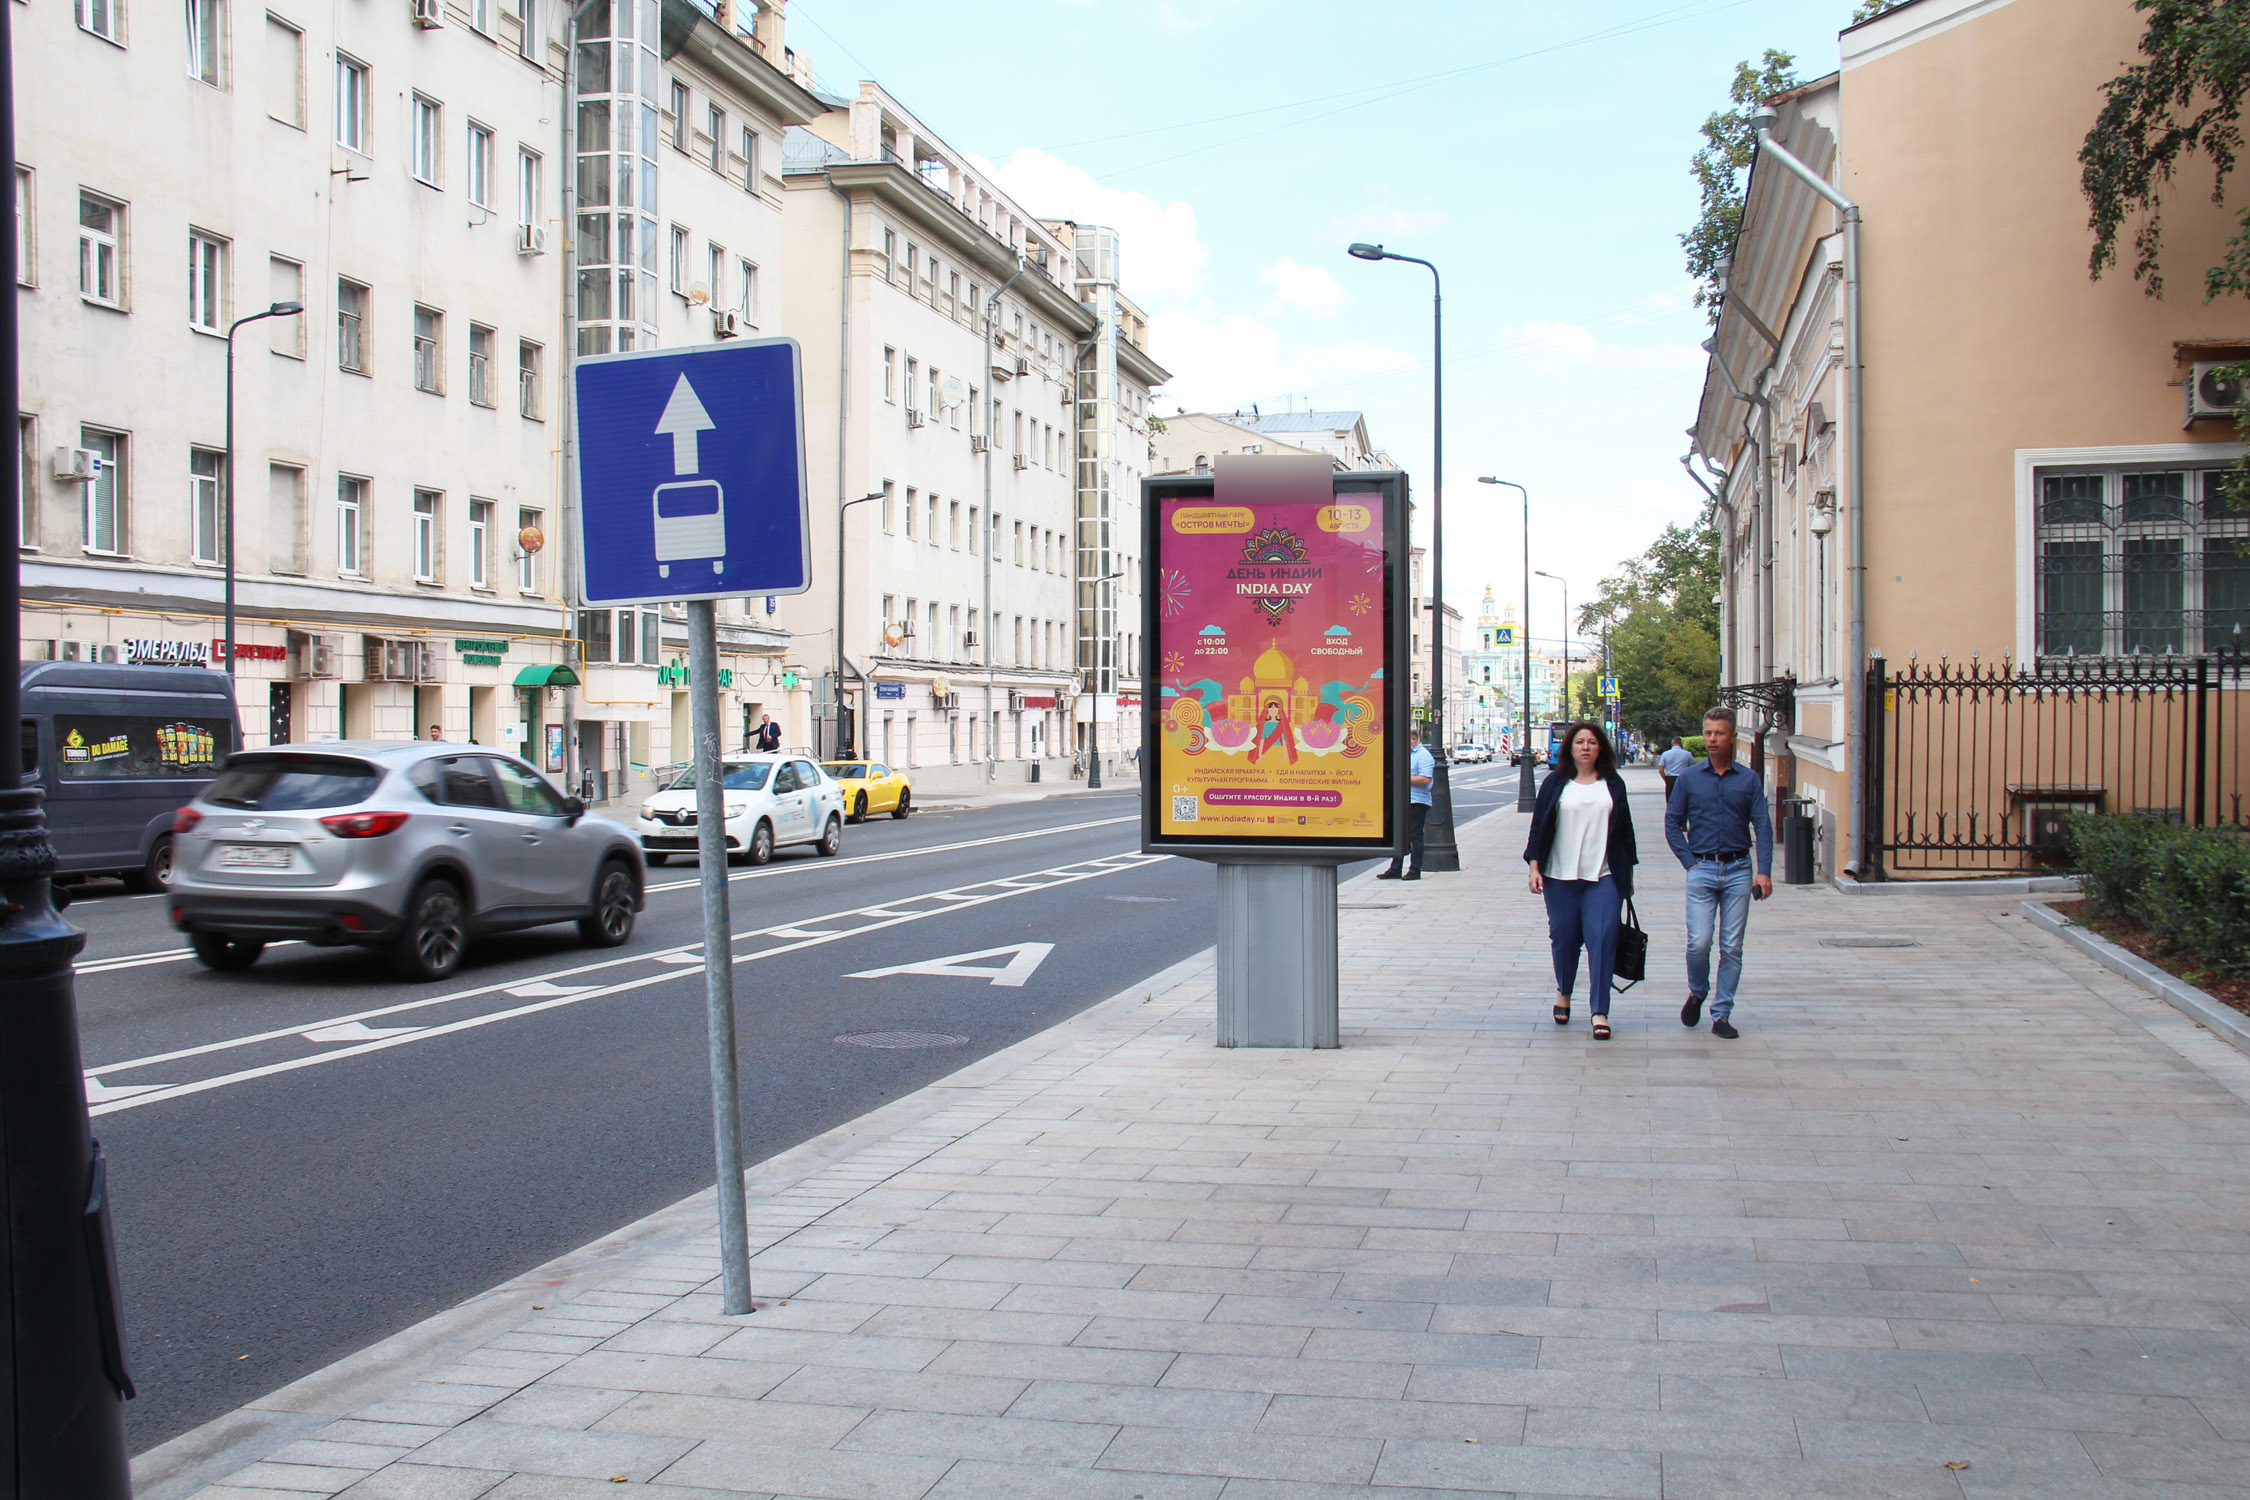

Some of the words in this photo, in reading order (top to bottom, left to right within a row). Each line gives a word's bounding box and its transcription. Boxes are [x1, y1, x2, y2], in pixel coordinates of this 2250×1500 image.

[1226, 568, 1266, 578] ДЕНЬ
[1270, 568, 1322, 578] ИНДИИ
[1236, 583, 1279, 594] INDIA
[1282, 583, 1312, 594] DAY
[1326, 638, 1348, 646] ВХОД
[128, 638, 210, 660] ЭМЕРАЛЬД
[1310, 646, 1363, 656] СВОБОДНЫЙ
[92, 744, 100, 756] DO
[102, 740, 128, 754] DAMAGE
[1172, 784, 1188, 793] 0+
[1200, 816, 1265, 824] www.indiaday.ru
